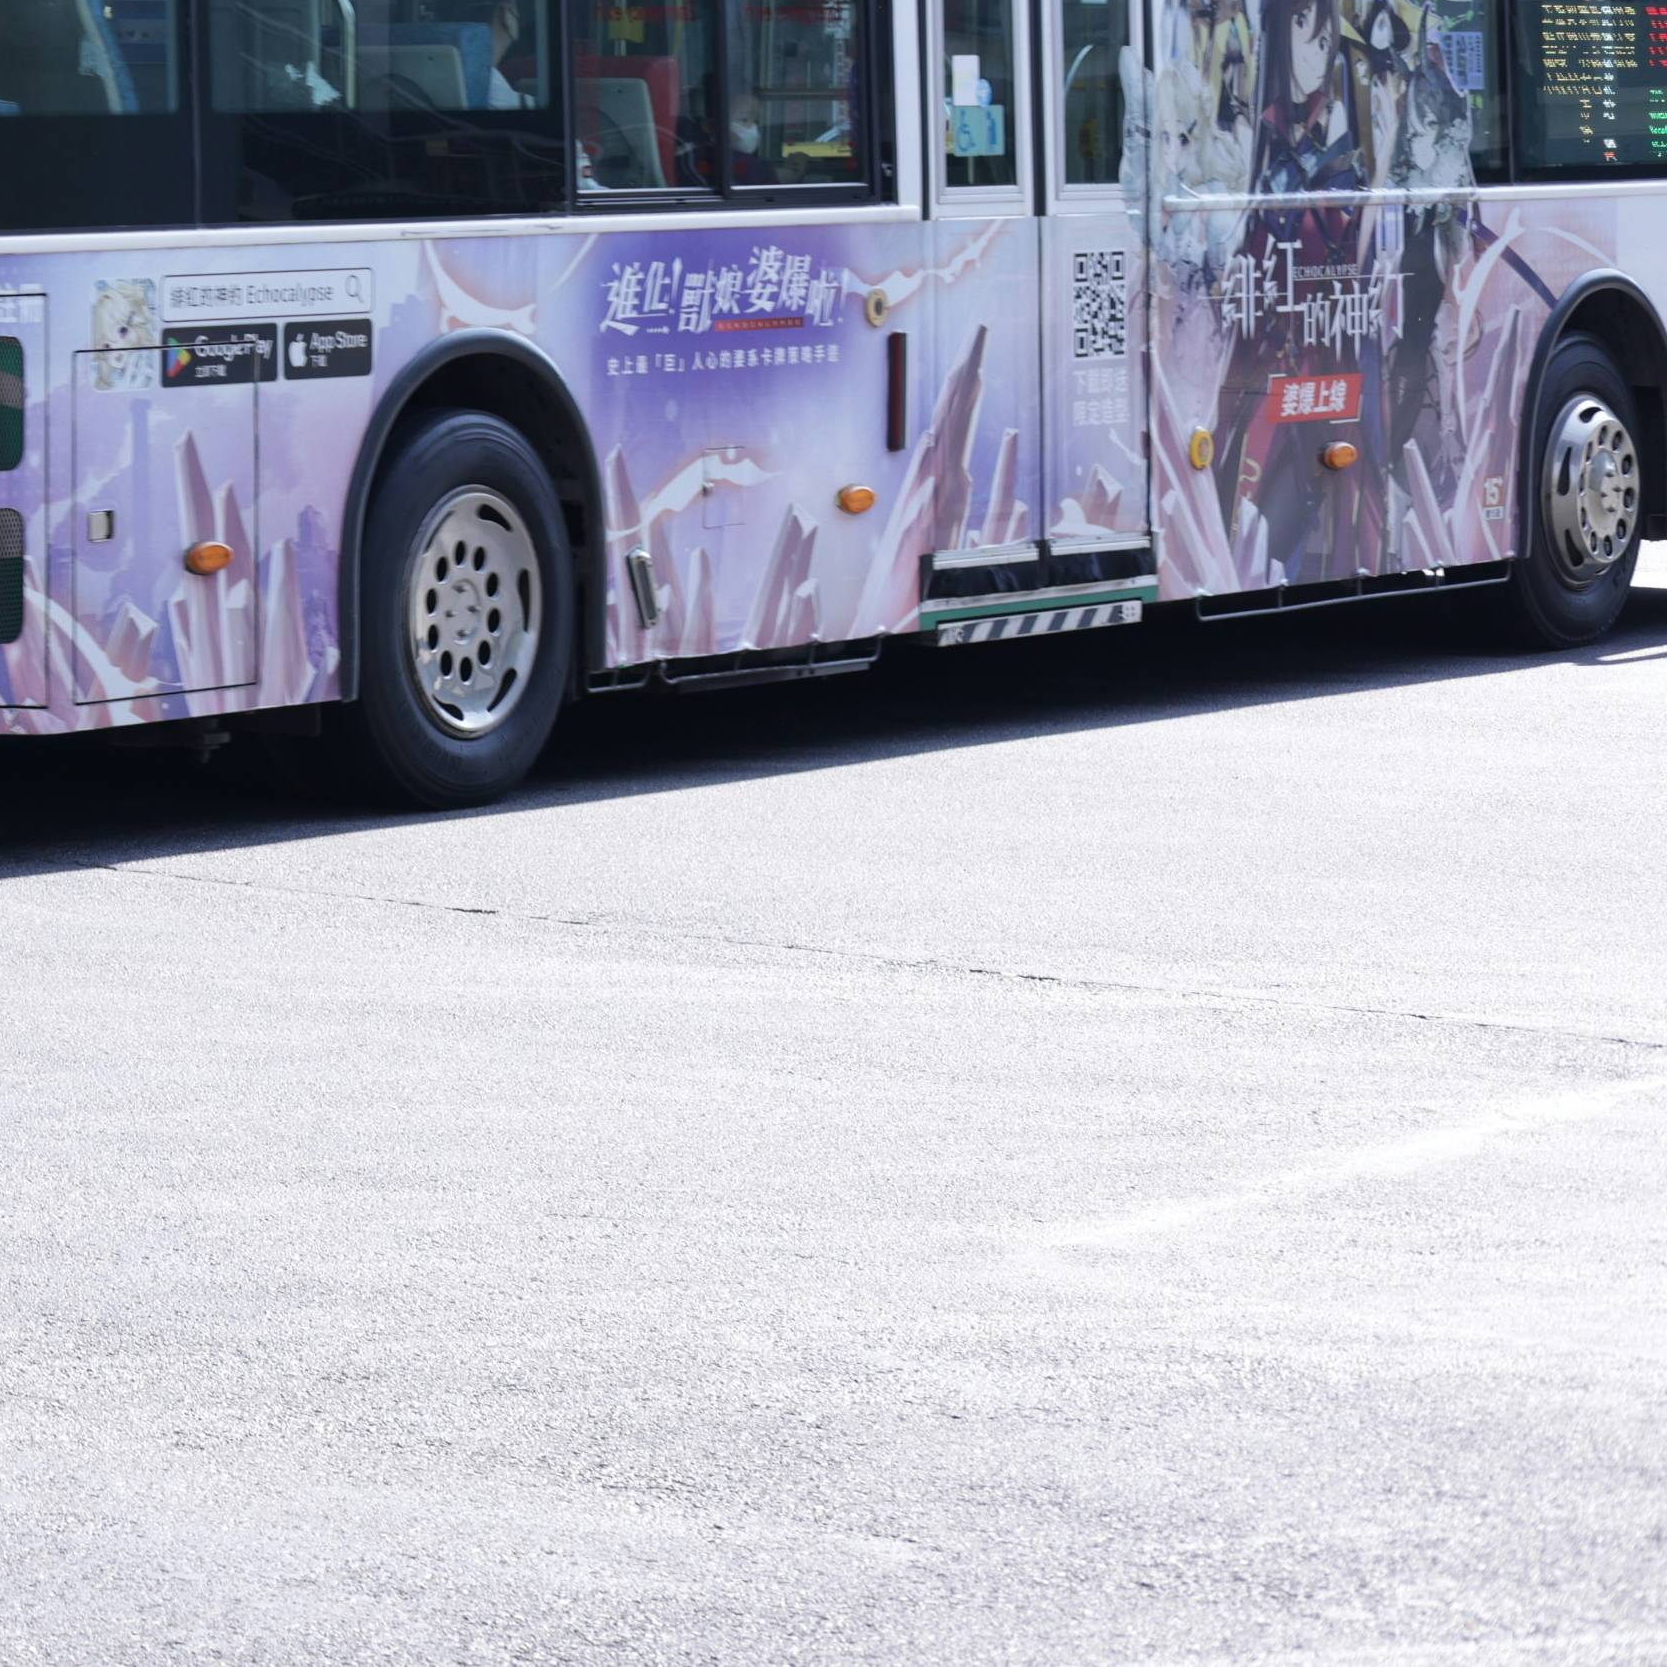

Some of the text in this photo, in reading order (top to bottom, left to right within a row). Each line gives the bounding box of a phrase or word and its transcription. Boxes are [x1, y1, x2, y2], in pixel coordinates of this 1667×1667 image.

[246, 282, 336, 306] Echocalypse
[194, 335, 244, 361] Google
[309, 330, 367, 353] App Store
